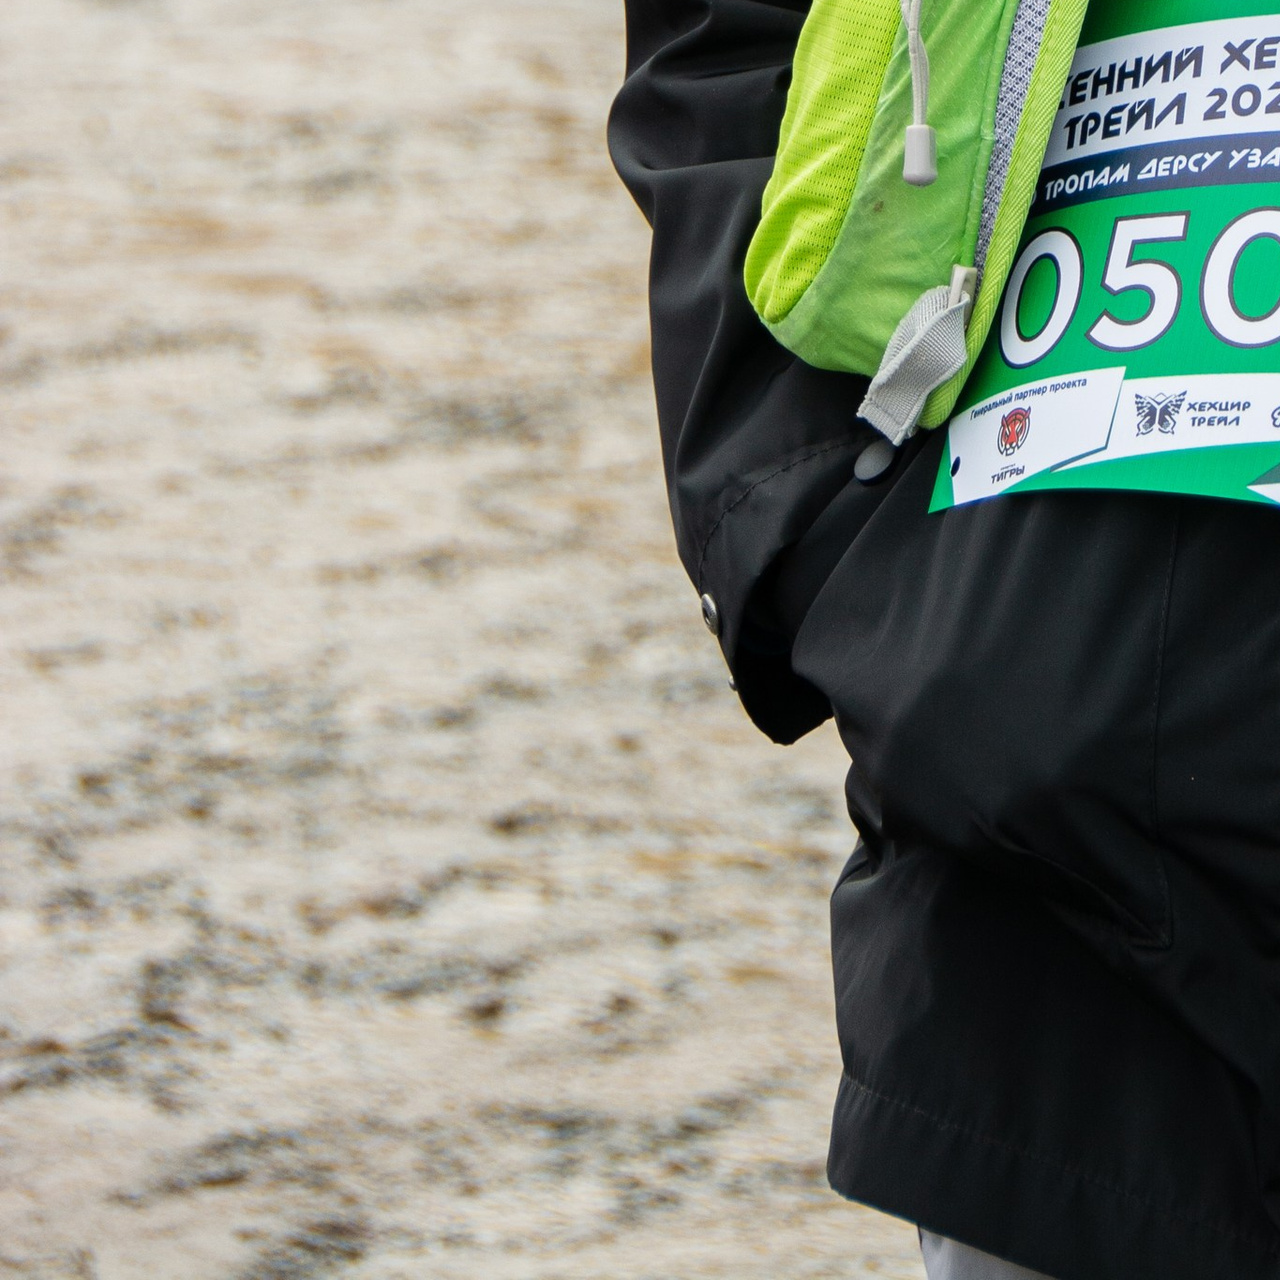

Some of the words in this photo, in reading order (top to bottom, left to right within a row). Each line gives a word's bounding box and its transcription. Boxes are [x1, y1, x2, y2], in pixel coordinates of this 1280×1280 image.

[1063, 92, 1187, 150] ТРЕЙЛ
[1045, 158, 1130, 200] ТРОПАМ
[1137, 149, 1223, 180] ДЕРСУ
[970, 393, 1013, 420] Генеральный
[1014, 386, 1047, 402] партнер
[1049, 378, 1087, 393] проекта
[1186, 401, 1251, 412] ХЕХЦИР
[1190, 416, 1241, 427] ТРЕЙЛ
[991, 465, 1025, 484] ТИГРЫ
